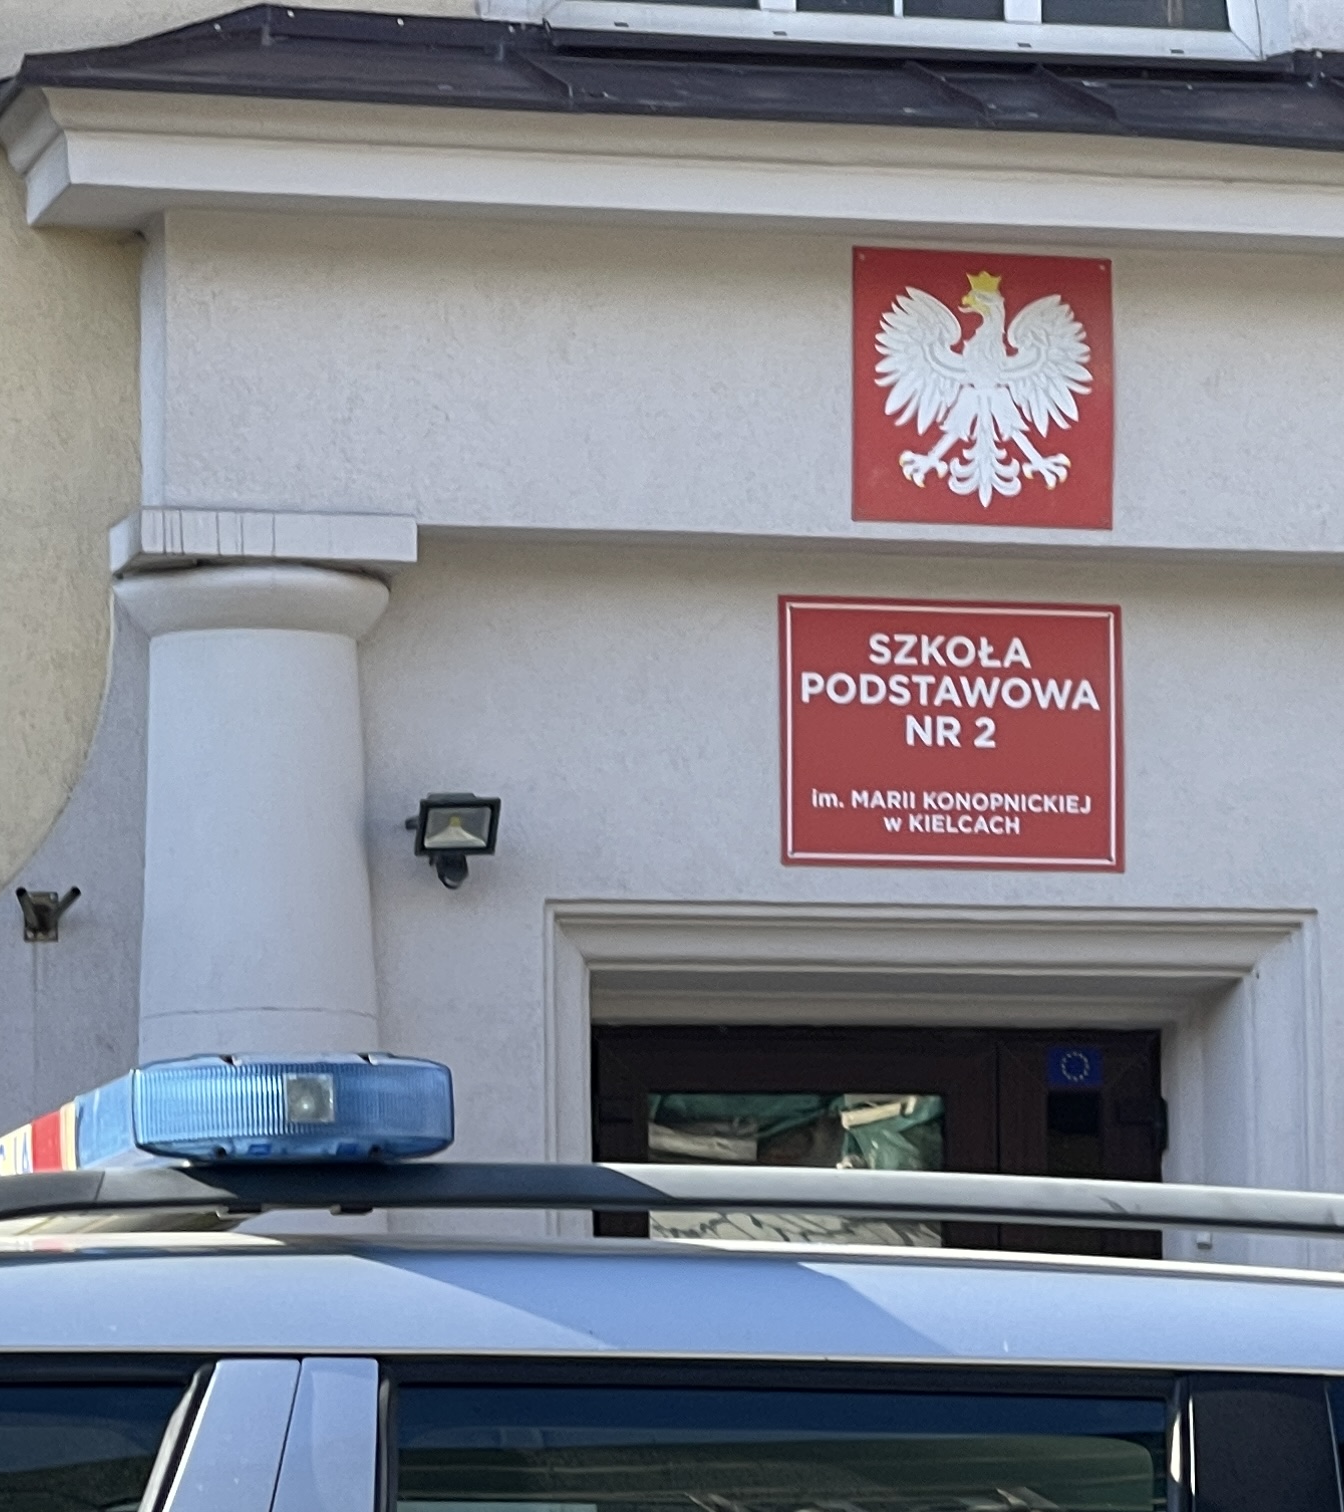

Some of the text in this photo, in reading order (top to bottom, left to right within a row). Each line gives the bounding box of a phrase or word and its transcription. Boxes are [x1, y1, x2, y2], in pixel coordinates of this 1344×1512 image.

[868, 632, 1032, 669] SZKOŁA
[800, 671, 1101, 711] PODSTAWOWA
[905, 714, 997, 748] NR 2
[811, 788, 1092, 815] im. MARII KONOPNICKIEJ
[883, 813, 1021, 834] w KIELCACH
